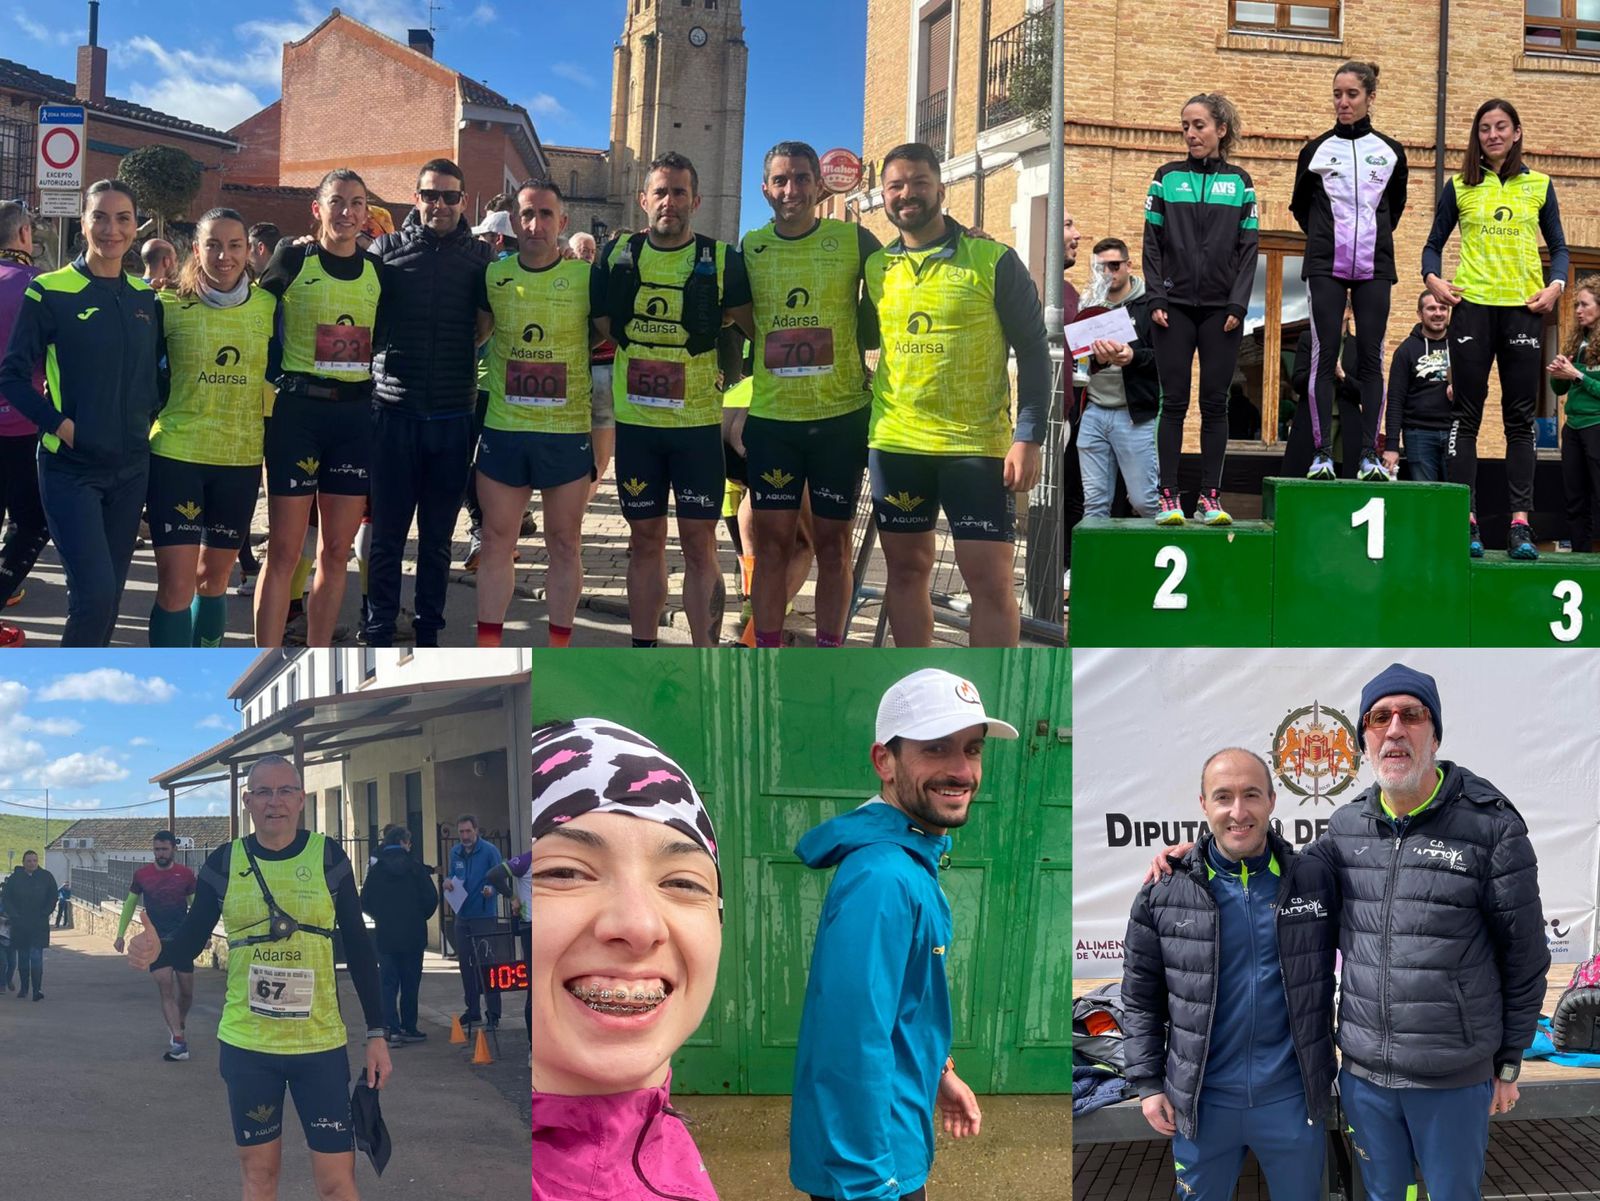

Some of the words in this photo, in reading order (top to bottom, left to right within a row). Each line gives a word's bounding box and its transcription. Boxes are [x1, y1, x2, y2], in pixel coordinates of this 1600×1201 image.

[39, 179, 80, 187] AUTORIZADOS
[1211, 182, 1236, 194] AVS
[1480, 224, 1520, 236] Adarsa
[631, 319, 678, 334] Adarsa
[771, 313, 820, 328] Adarsa
[331, 338, 360, 361] 23
[509, 345, 554, 360] Adarsa
[780, 341, 816, 367] 70
[894, 339, 945, 354] Adarsa
[197, 370, 248, 385] Adarsa
[511, 374, 558, 396] 100
[637, 372, 671, 397] 58
[891, 515, 930, 524] AQUONA
[1351, 497, 1386, 560] 1
[1152, 545, 1189, 610] 2
[1548, 579, 1584, 643] 3
[252, 947, 302, 961] Adarsa
[1076, 952, 1089, 960] DE
[256, 980, 287, 1001] 67
